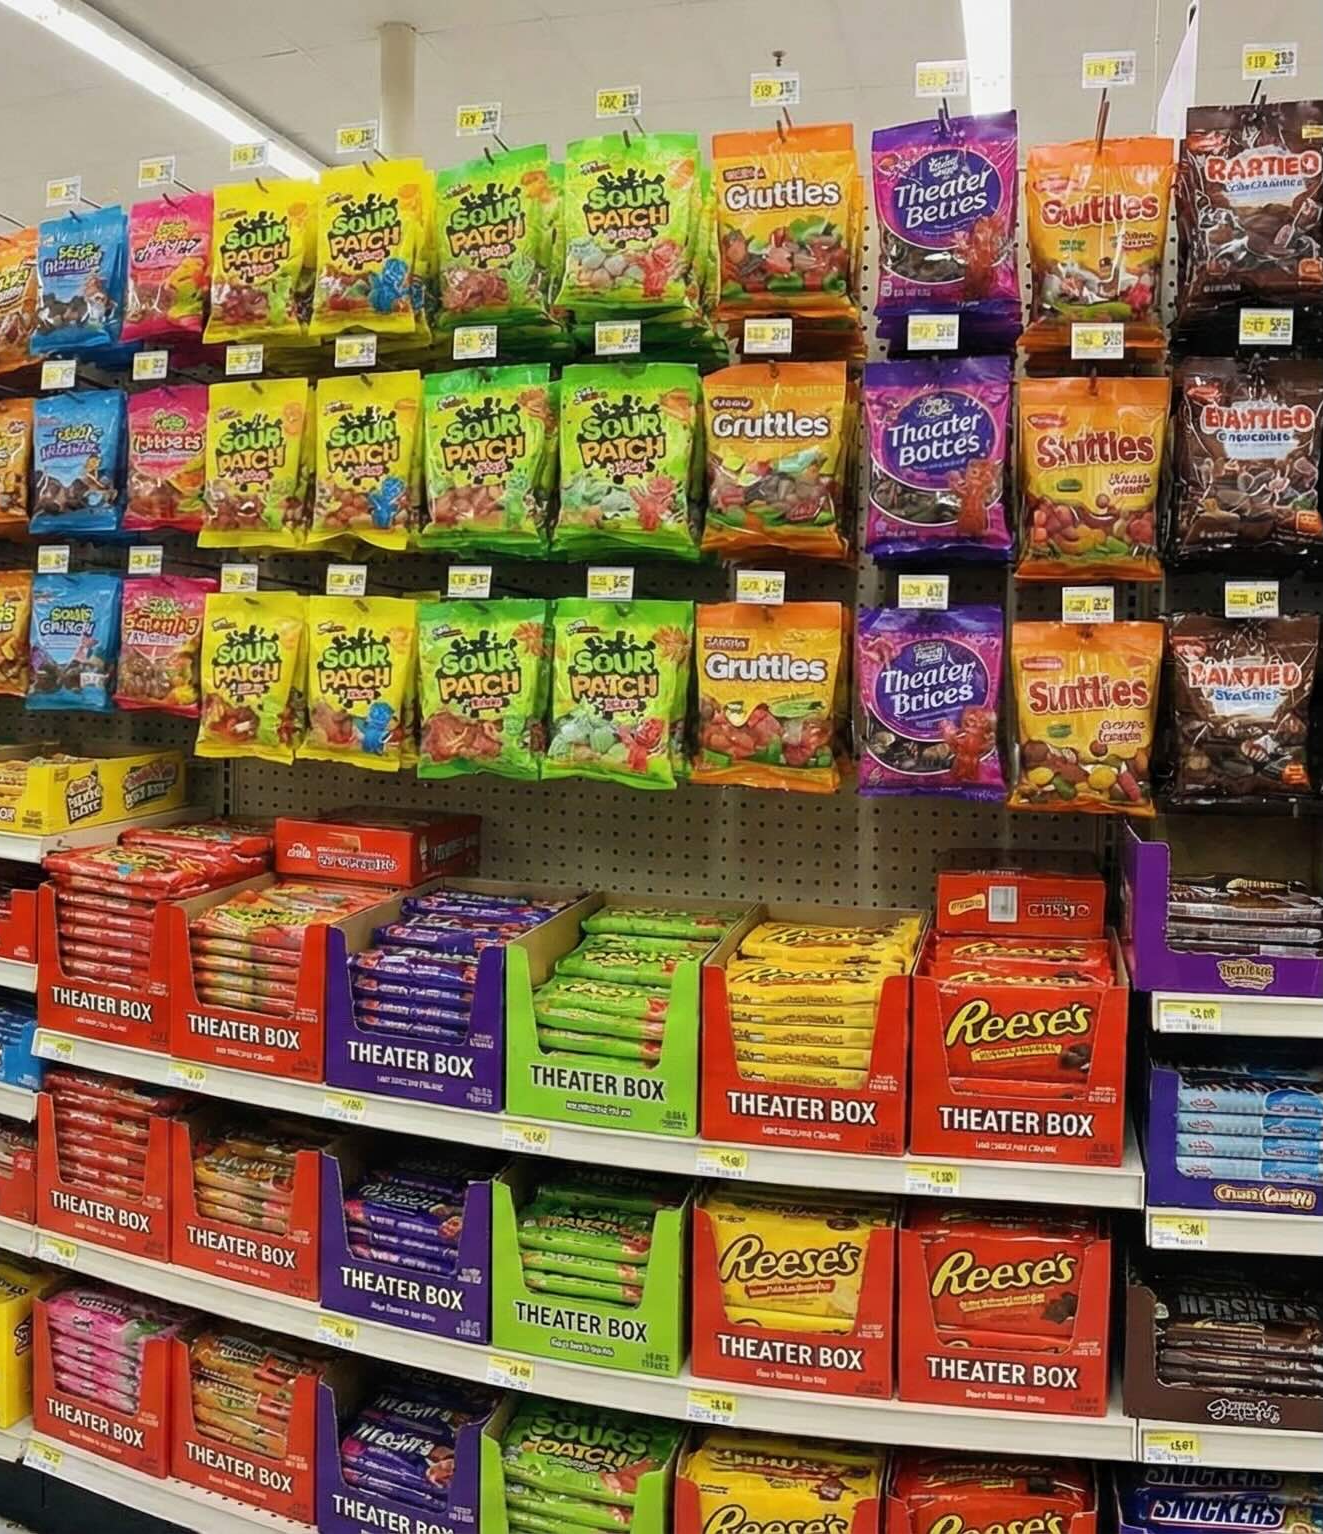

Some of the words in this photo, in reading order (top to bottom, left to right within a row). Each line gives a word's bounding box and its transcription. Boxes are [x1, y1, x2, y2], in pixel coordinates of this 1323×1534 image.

[587, 183, 665, 210] SOUR
[894, 168, 993, 208] Theater
[333, 206, 398, 236] SOUR
[451, 196, 521, 228] SOUR
[586, 204, 670, 235] PATCH
[224, 222, 287, 250] SOUR
[328, 226, 401, 260] PATCH
[449, 217, 526, 255] PATCH
[223, 242, 289, 271] PATCH
[220, 426, 283, 452] SOUR
[328, 418, 396, 446] SOUR
[447, 411, 520, 441] SOUR
[582, 413, 661, 441] SOUR
[713, 412, 829, 439] Gruttles
[217, 447, 286, 474] PATCH
[328, 440, 400, 466] PATCH
[444, 436, 525, 468] PATCH
[580, 435, 666, 465] PATCH
[216, 641, 279, 664] SOUR
[323, 645, 389, 669] SOUR
[442, 650, 518, 675] SOUR
[574, 650, 655, 674] SOUR
[705, 652, 827, 682] Gruttles
[213, 661, 280, 687] PATCH
[320, 665, 391, 692] PATCH
[438, 673, 520, 700] PATCH
[571, 672, 659, 699] PATCH
[880, 661, 977, 694] Theater
[890, 684, 974, 718] Brices
[51, 986, 116, 1016] THEATER
[120, 997, 153, 1022] BOX
[188, 1014, 260, 1045] THEATER
[264, 1025, 301, 1051] BOX
[945, 1000, 1092, 1047] Reese's
[347, 1041, 430, 1072] THEATER
[434, 1053, 475, 1079] BOX
[530, 1065, 619, 1097] THEATER
[623, 1076, 665, 1101] BOX
[726, 1091, 826, 1120] THEATER
[831, 1099, 877, 1125] BOX
[939, 1106, 1041, 1133] THEATER
[1046, 1112, 1094, 1137] BOX
[50, 1190, 115, 1224] THEATER
[118, 1205, 151, 1233] BOX
[187, 1225, 257, 1260] THEATER
[261, 1242, 297, 1270] BOX
[719, 1233, 863, 1283] Reese's
[341, 1267, 421, 1301] THEATER
[425, 1283, 464, 1311] BOX
[930, 1250, 1078, 1298] Reese's
[515, 1302, 602, 1337] THEATER
[606, 1319, 649, 1344] BOX
[718, 1334, 814, 1367] THEATER
[818, 1346, 864, 1372] BOX
[927, 1356, 1028, 1387] THEATER
[1032, 1365, 1079, 1390] BOX
[47, 1398, 110, 1436] THEATER
[113, 1420, 145, 1450] BOX
[185, 1440, 255, 1481] THEATER
[258, 1466, 293, 1494] BOX
[332, 1494, 410, 1534] THEATER
[1151, 1499, 1283, 1526] SNICKERS
